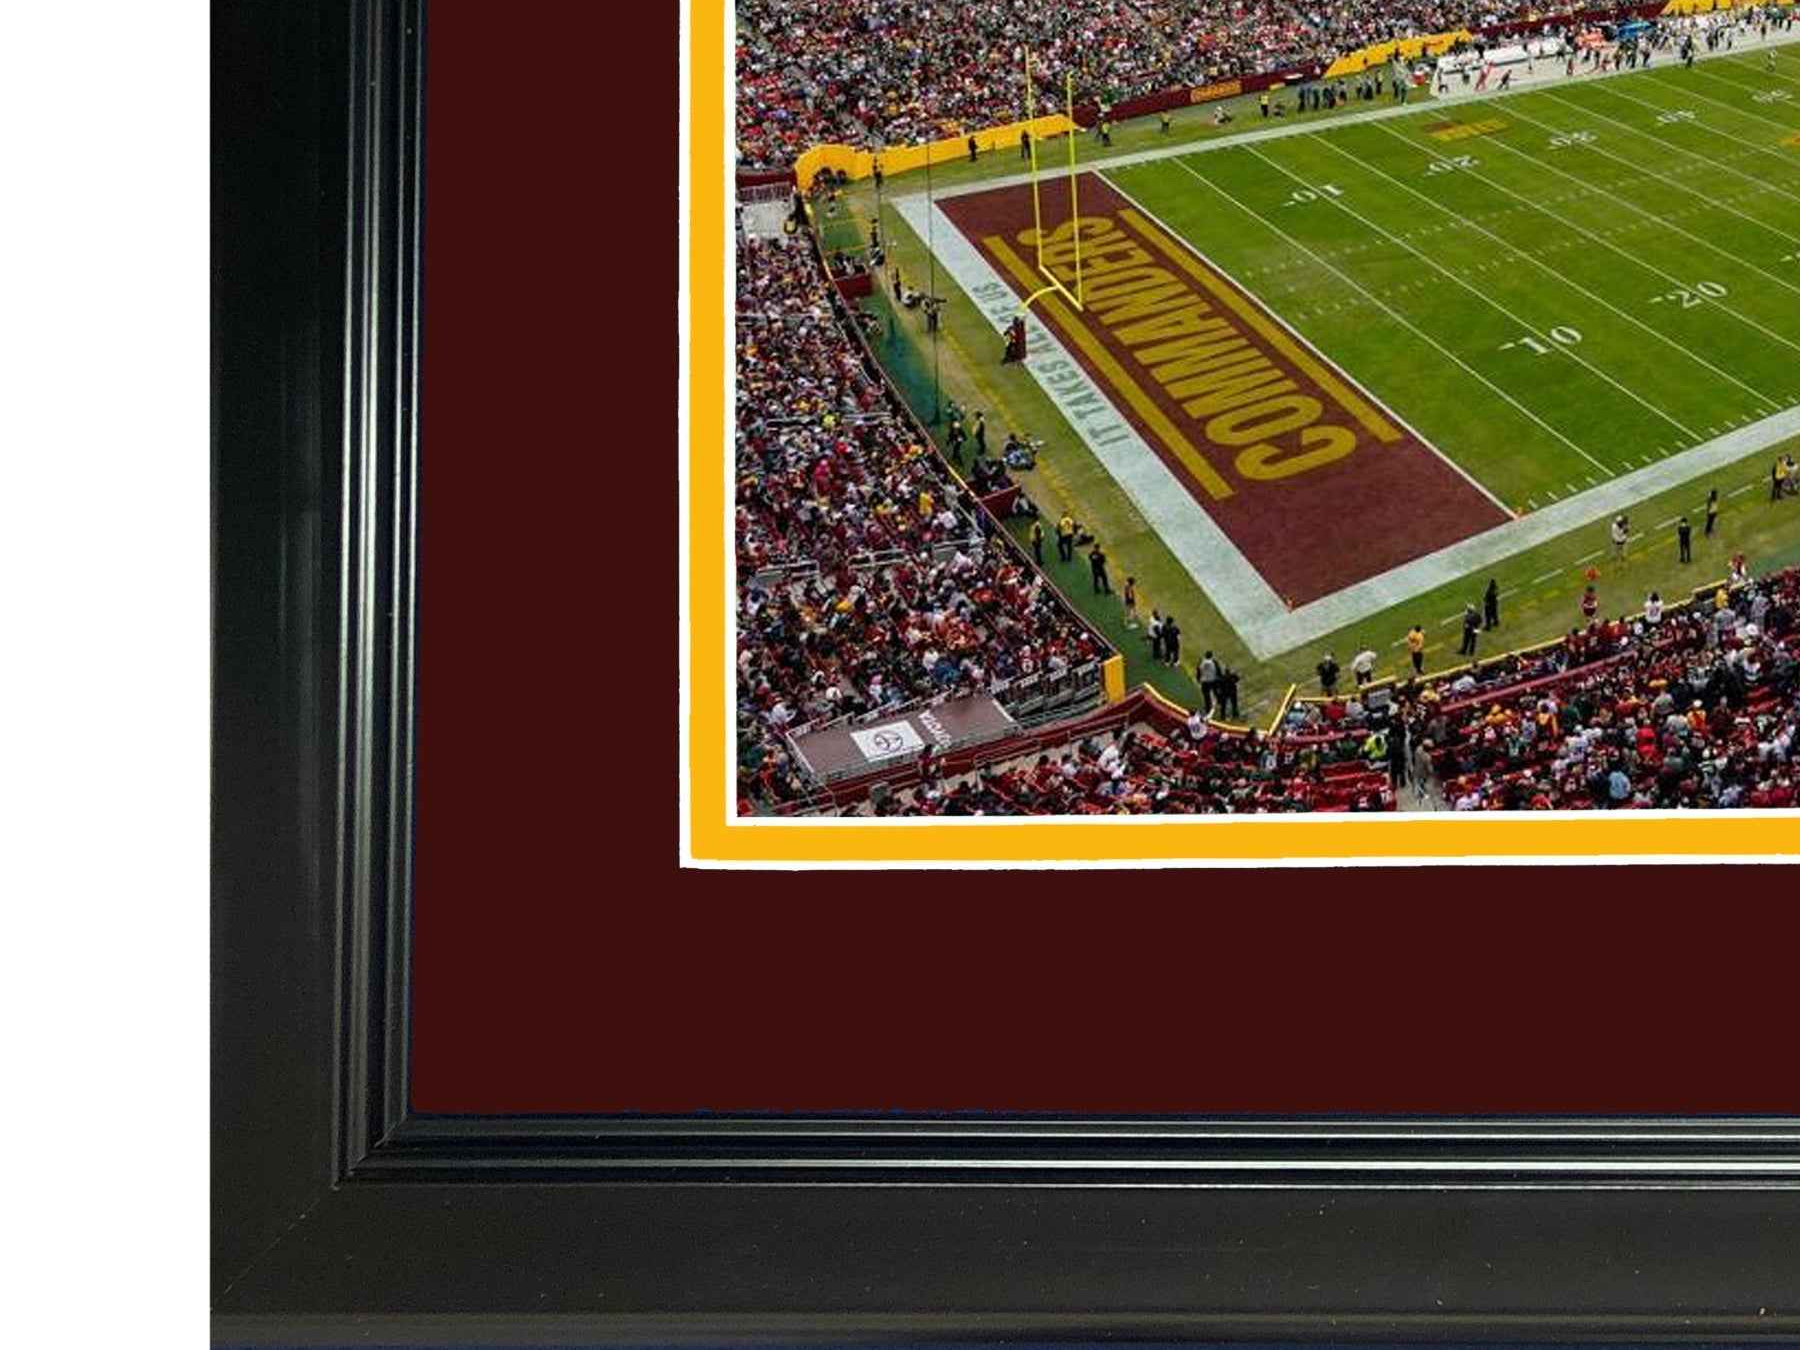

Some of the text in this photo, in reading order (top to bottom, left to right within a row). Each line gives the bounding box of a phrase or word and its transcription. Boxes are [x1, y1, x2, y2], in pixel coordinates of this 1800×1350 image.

[1666, 279, 1730, 310] 20
[1016, 216, 1357, 481] COMMANDERS
[1519, 324, 1584, 357] 10
[1037, 359, 1106, 420] TAKES
[1088, 423, 1131, 447] IT
